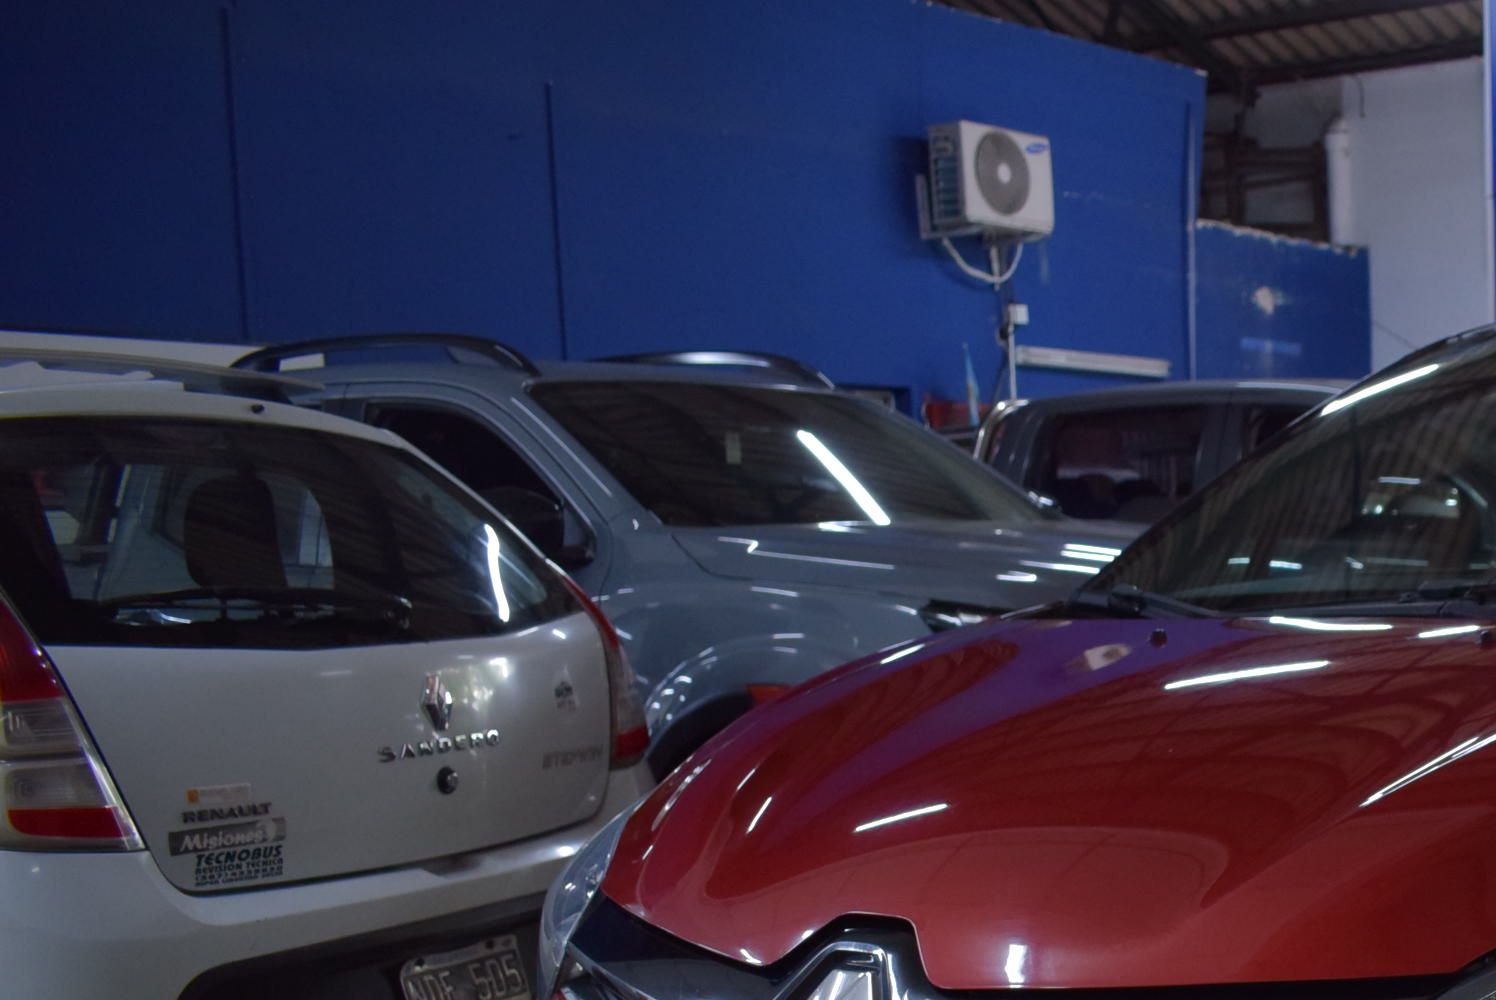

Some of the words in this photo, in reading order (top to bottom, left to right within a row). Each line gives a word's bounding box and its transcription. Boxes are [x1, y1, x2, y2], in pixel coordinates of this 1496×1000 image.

[378, 729, 500, 762] SANDERO
[182, 803, 271, 824] RENAULT
[196, 845, 283, 867] TECNOBUS
[469, 955, 522, 1000] 505
